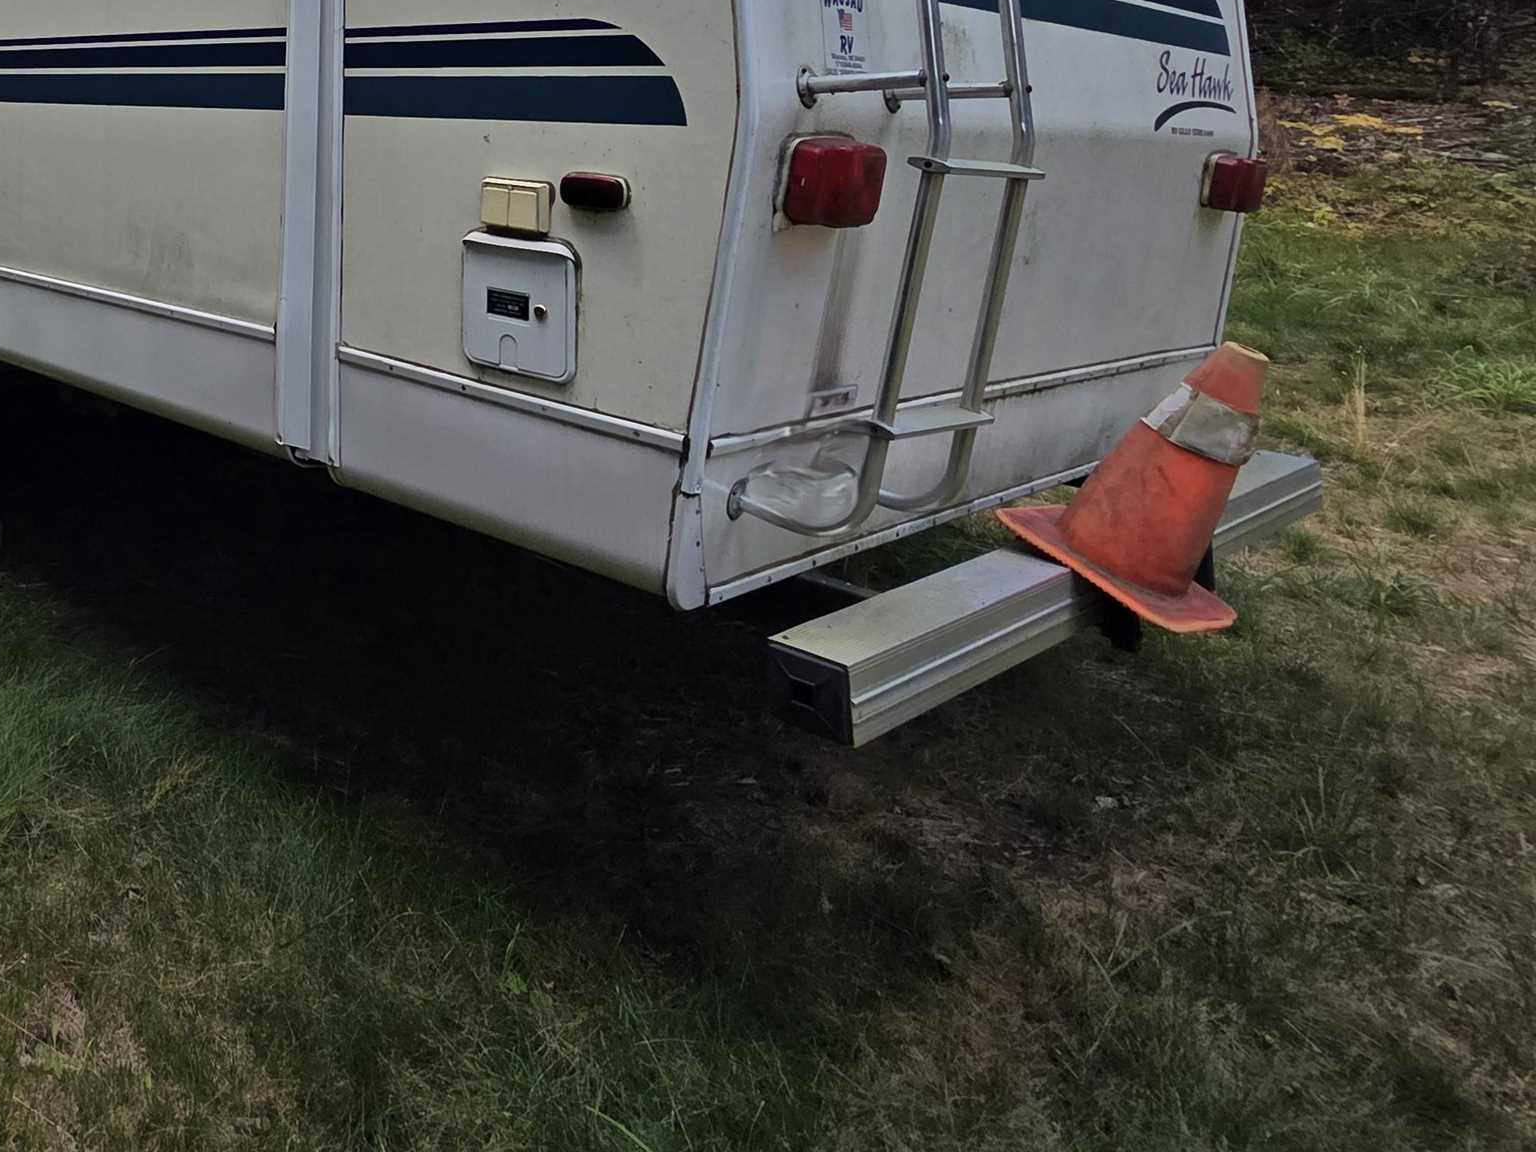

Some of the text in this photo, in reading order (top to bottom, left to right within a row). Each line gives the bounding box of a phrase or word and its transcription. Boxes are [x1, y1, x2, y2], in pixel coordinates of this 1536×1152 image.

[840, 35, 854, 55] RV
[1157, 50, 1234, 102] Sea Hawk
